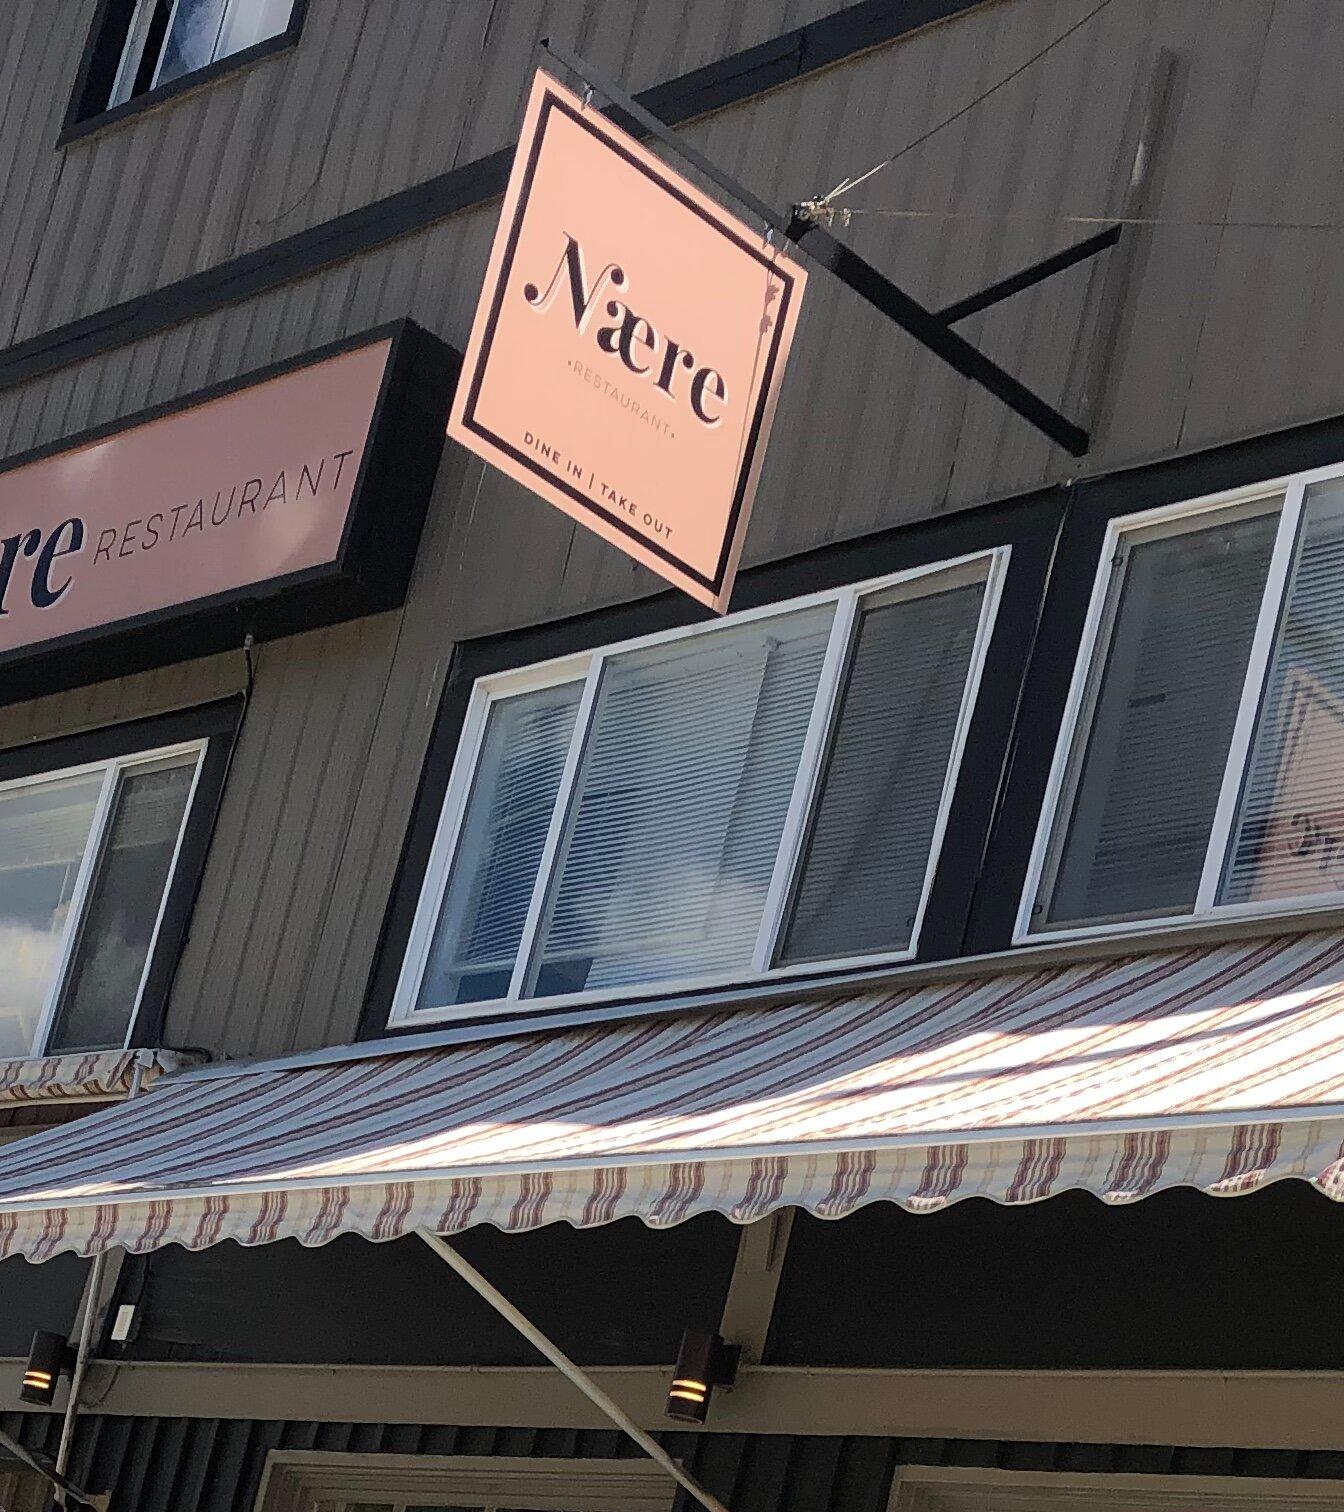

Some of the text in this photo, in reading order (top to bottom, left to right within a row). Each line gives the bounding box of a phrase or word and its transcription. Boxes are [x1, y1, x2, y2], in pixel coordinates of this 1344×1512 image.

[523, 230, 728, 426] Nære
[94, 450, 355, 567] RESTAURANT
[523, 431, 673, 539] DINE IN TAKE OUT
